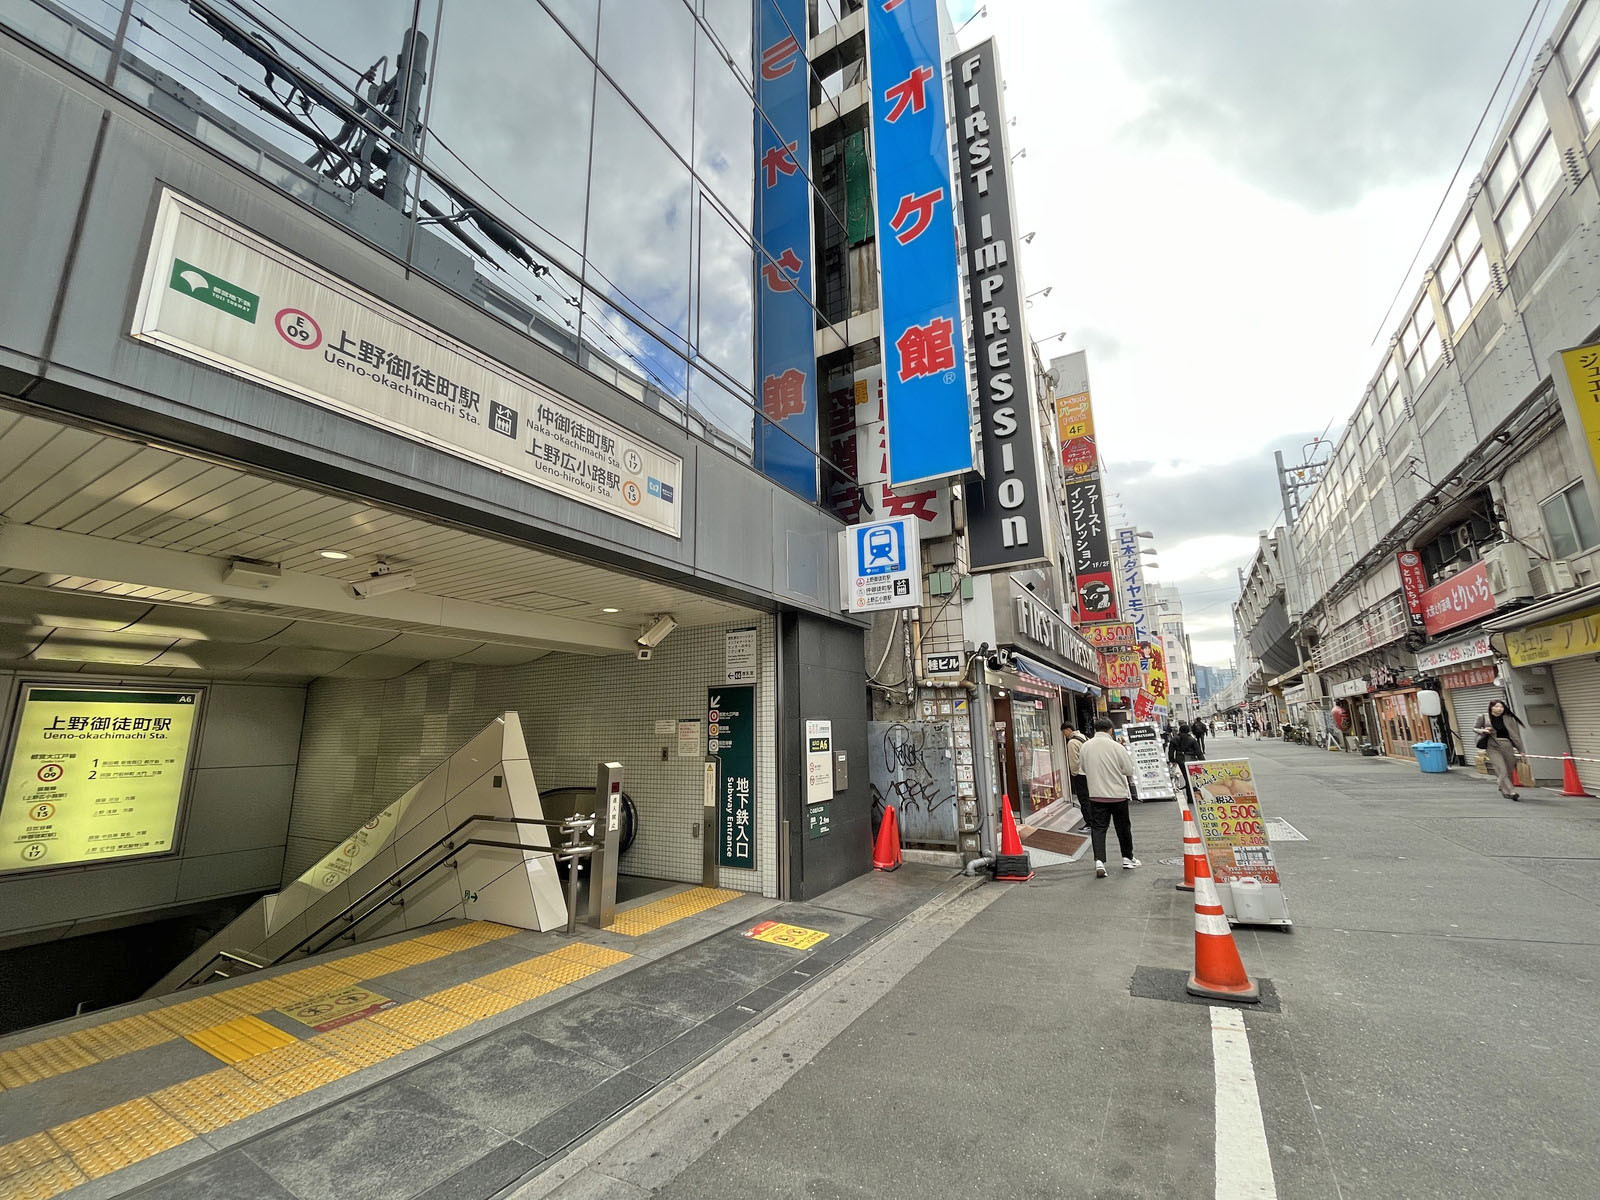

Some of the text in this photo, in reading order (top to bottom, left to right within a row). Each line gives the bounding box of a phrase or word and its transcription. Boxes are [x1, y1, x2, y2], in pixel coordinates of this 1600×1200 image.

[961, 54, 993, 196] FIRST
[287, 325, 309, 342] 09
[297, 316, 304, 327] E
[328, 330, 480, 412] 上野御徒町駅
[324, 350, 480, 426] Ueno-okachimachi Sta.
[537, 404, 615, 456] 仲御徒町駅
[1069, 425, 1083, 435] 4F
[526, 418, 622, 469] Naka-okachimachi Sta.
[525, 438, 620, 491] 上野広小路駅
[628, 461, 638, 470] 17
[630, 453, 636, 461] H
[535, 460, 613, 498] Ueno-hirokoji Sta.
[629, 485, 635, 493] G
[627, 492, 637, 501] 15
[1084, 484, 1101, 537] ファースト
[1070, 487, 1092, 570] インプレッション
[1451, 575, 1488, 611] とりいち
[1017, 597, 1056, 650] FIRST
[179, 695, 192, 703] A6
[44, 716, 172, 732] 上野御徒町駅
[44, 732, 168, 740] Ueno-okachimachi Sta.
[819, 740, 828, 750] A6
[88, 770, 97, 780] 2
[92, 759, 99, 767] 1
[726, 777, 735, 858] Subway Entrance
[736, 777, 749, 858] 地下鉄入口
